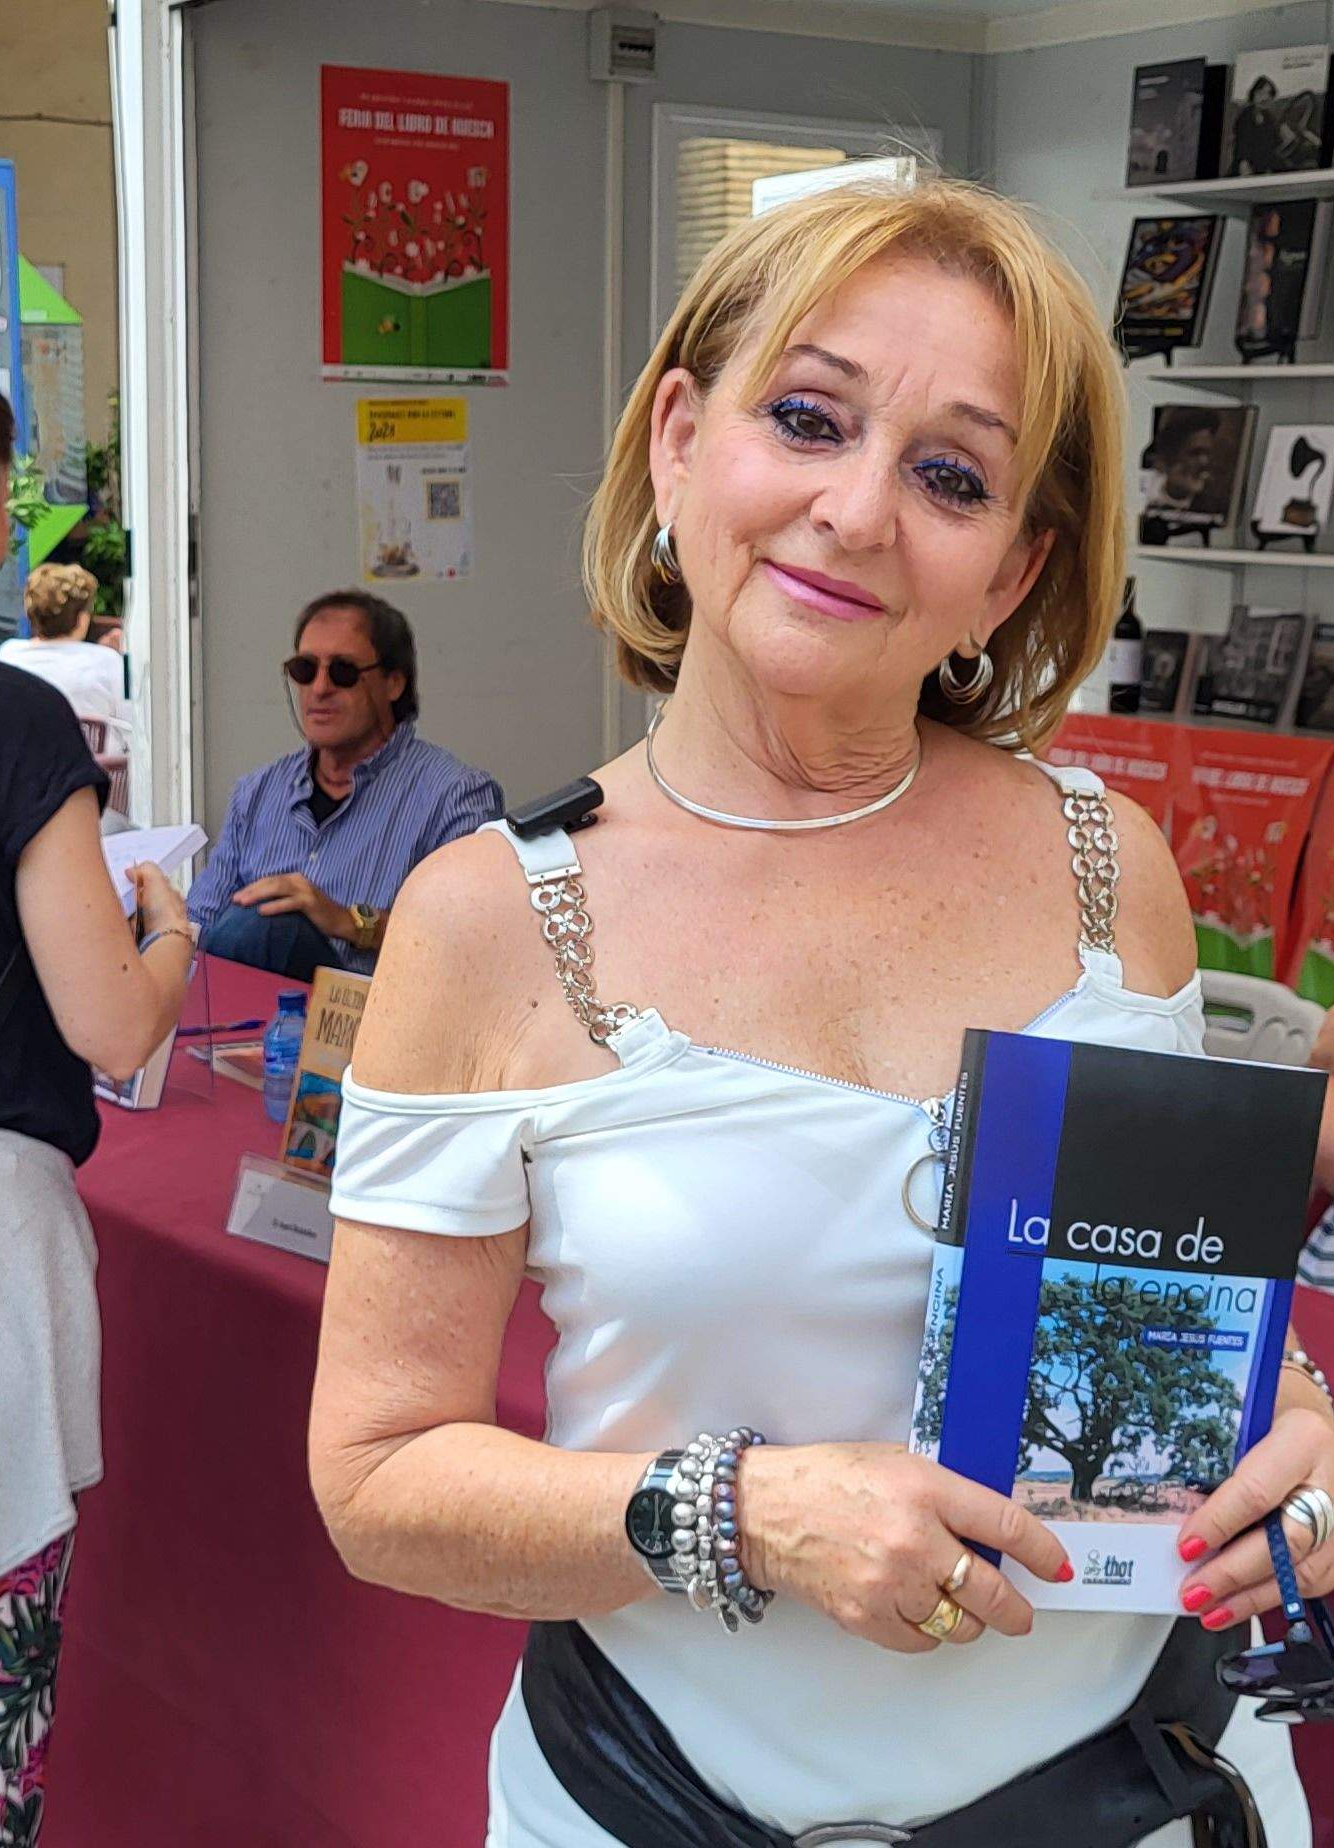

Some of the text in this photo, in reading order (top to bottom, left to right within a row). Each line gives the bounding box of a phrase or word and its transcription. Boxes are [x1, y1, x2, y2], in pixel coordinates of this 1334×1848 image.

[338, 107, 495, 140] FERIA DEL LIBRO DE HUESCA
[954, 1071, 969, 1131] FUENTES
[1008, 1197, 1225, 1264] La casa de
[1093, 1262, 1259, 1314] la encina
[1208, 1333, 1245, 1348] FUENTES
